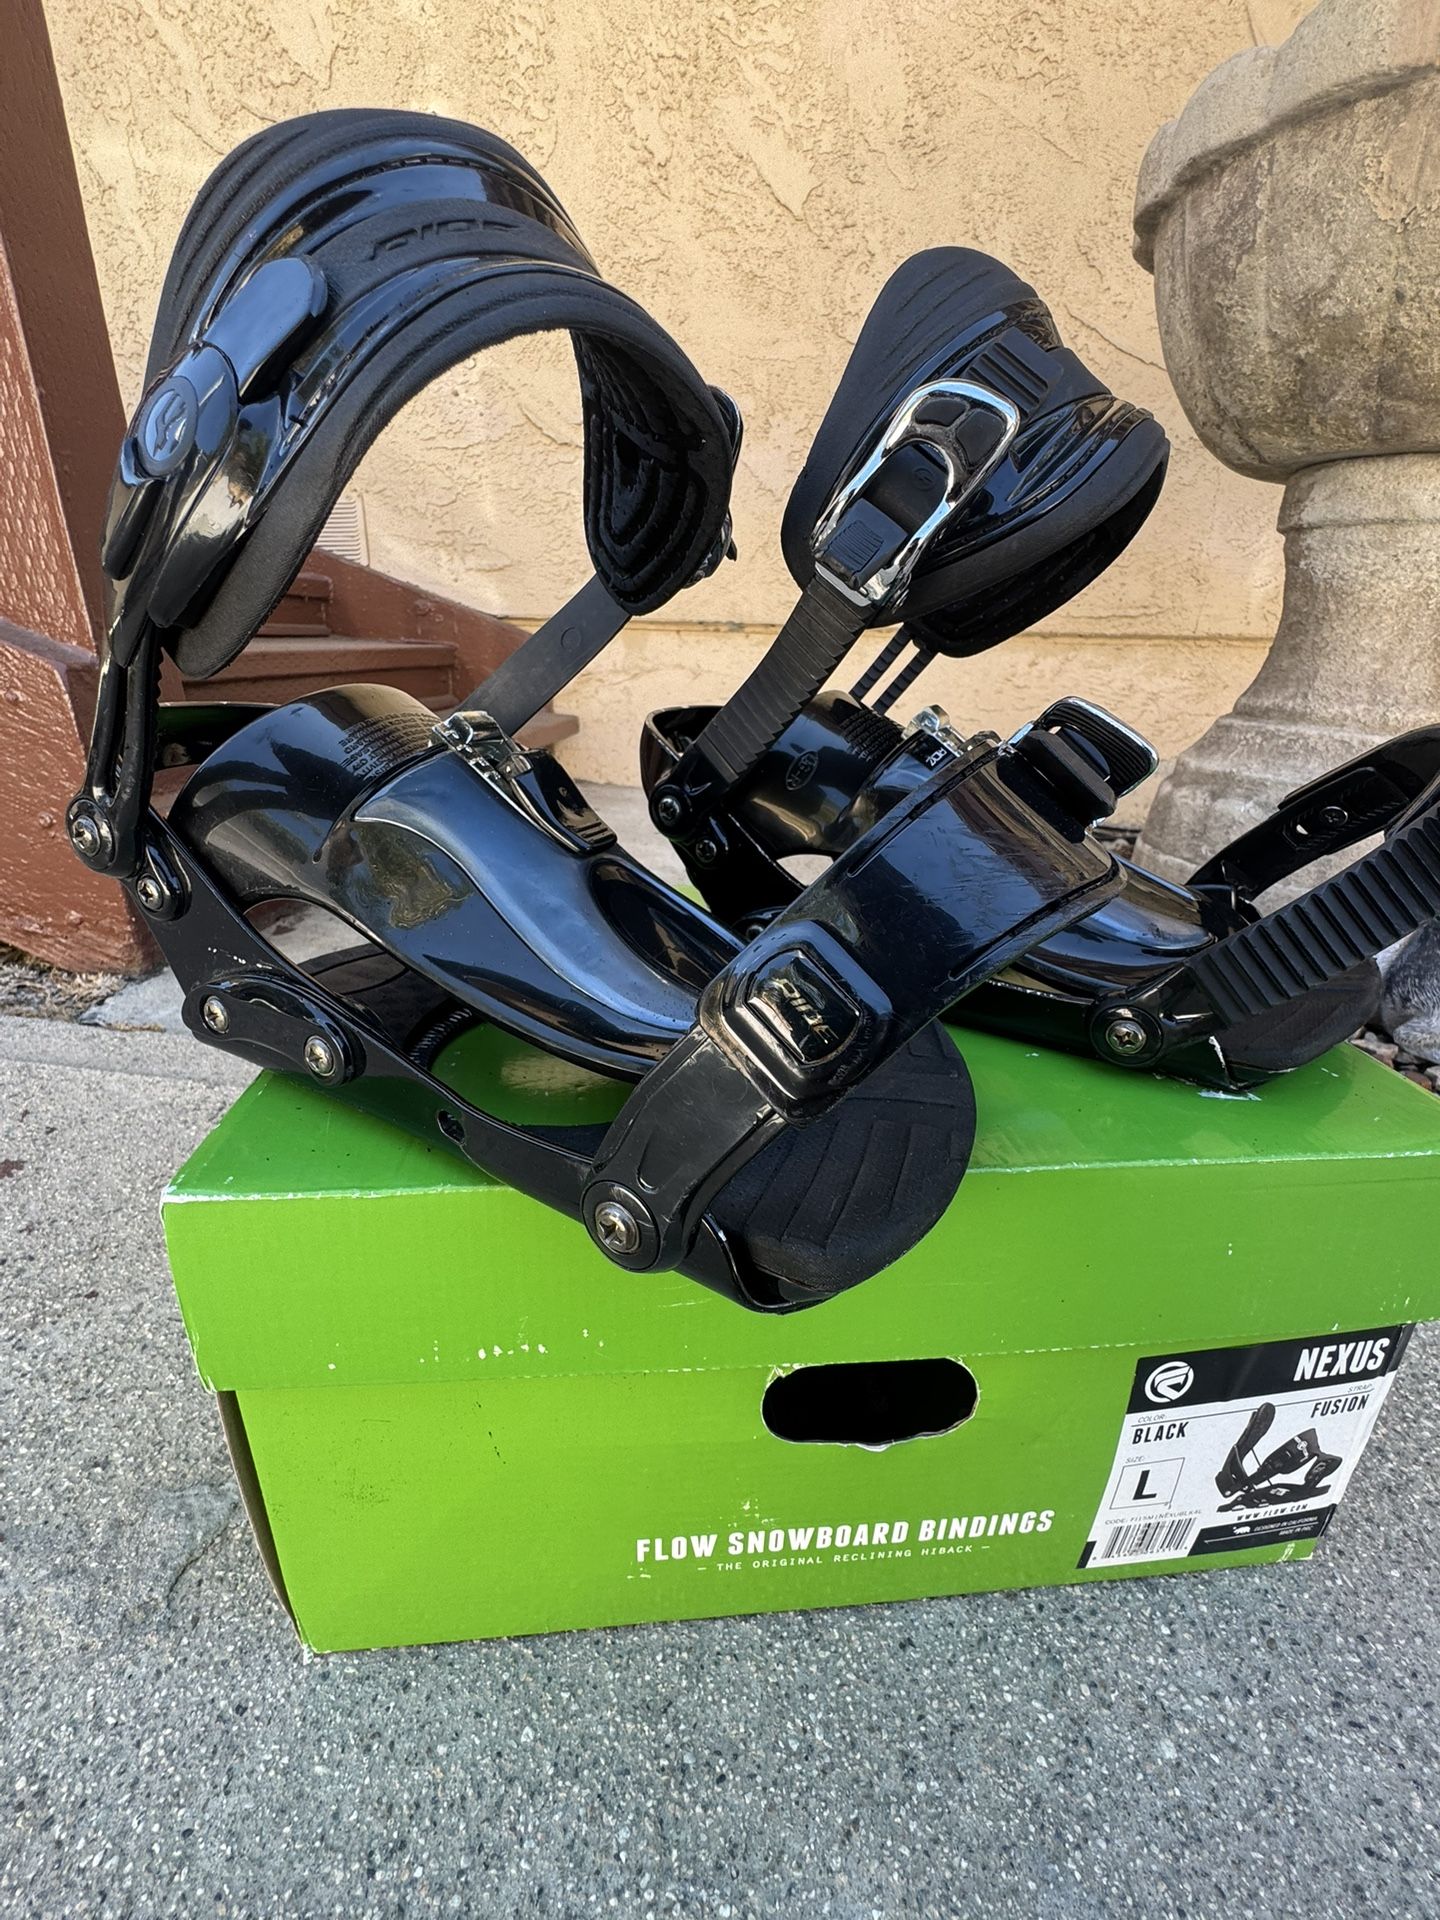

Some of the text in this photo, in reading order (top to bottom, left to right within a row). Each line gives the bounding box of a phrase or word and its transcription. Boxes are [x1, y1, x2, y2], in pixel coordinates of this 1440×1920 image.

[1293, 1337, 1390, 1381] NEXUS
[1310, 1393, 1369, 1418] FUSION
[1132, 1421, 1189, 1444] BLACK
[1132, 1469, 1157, 1500] L
[636, 1510, 1055, 1562] FLOW SNOWBOARD BINDINGS
[717, 1545, 973, 1571] THE ORIGINAL RECLINING HIBACK
